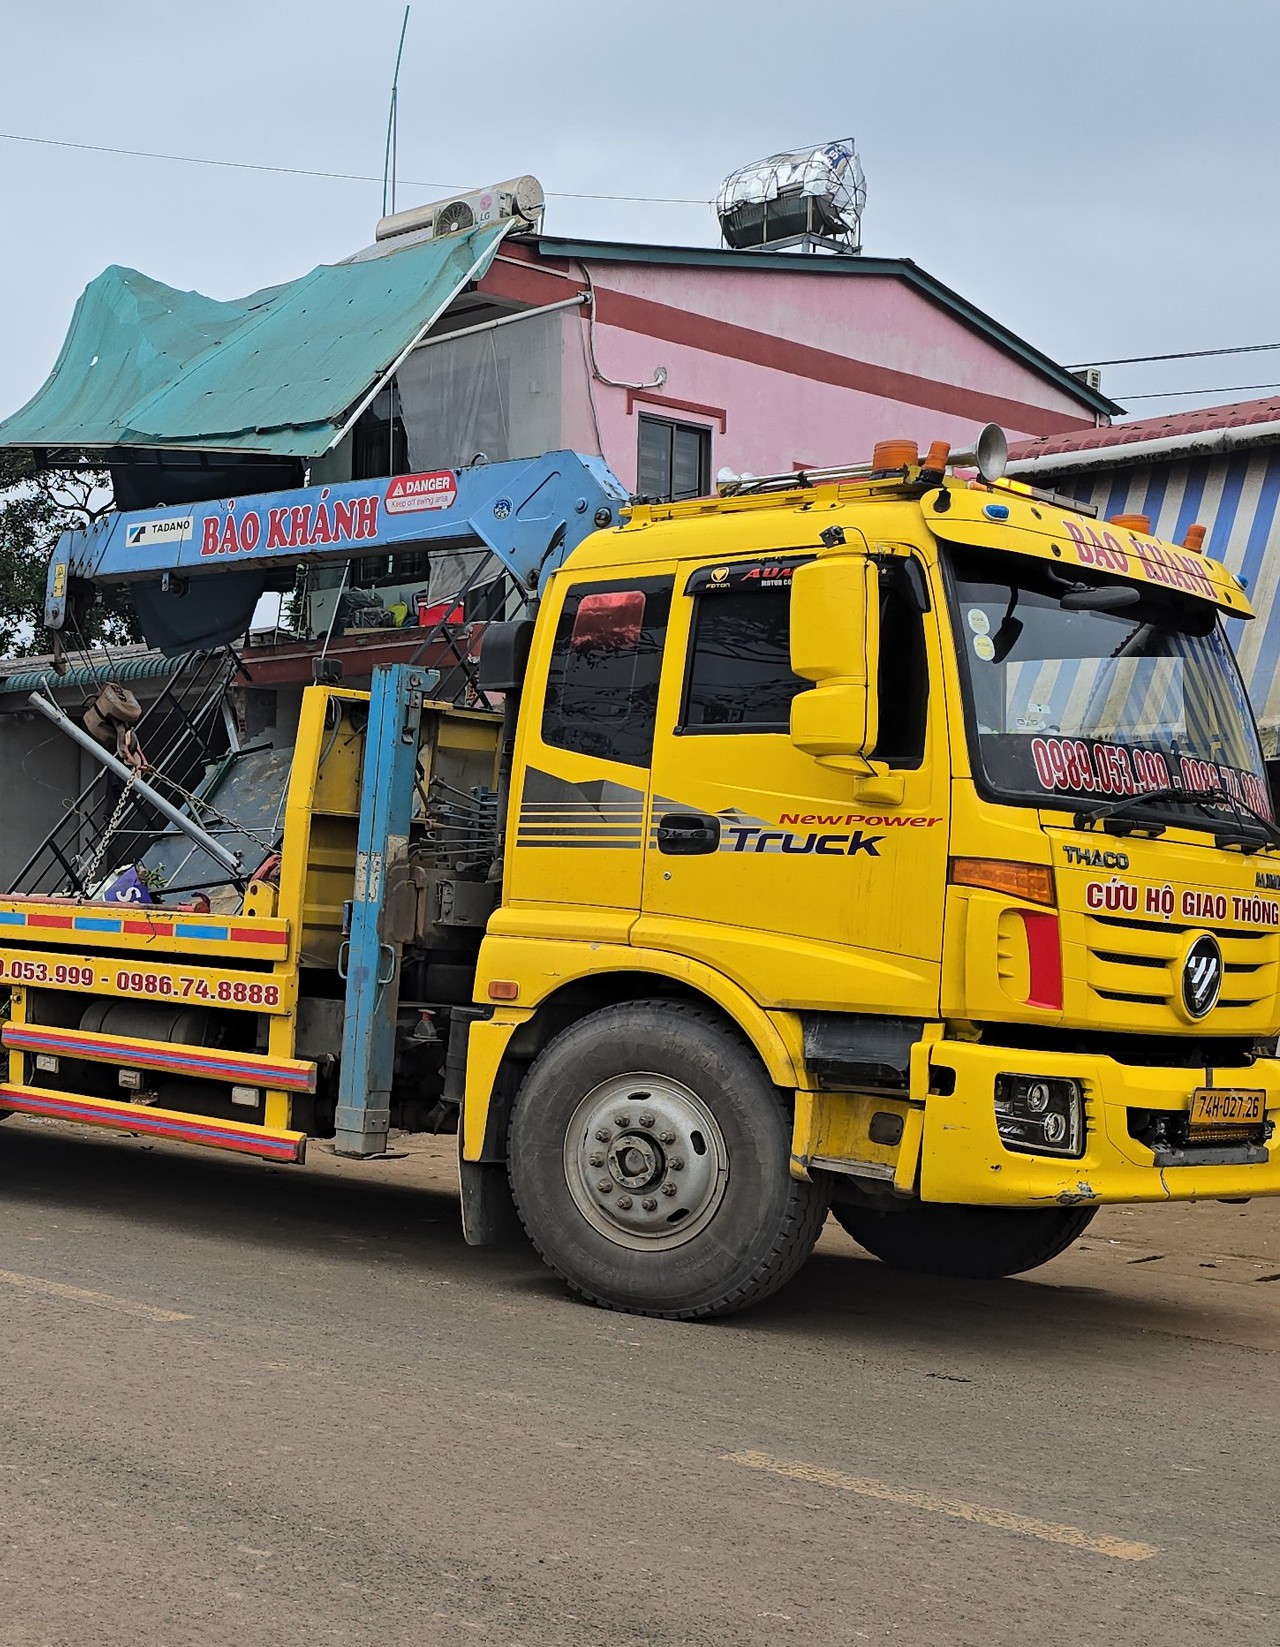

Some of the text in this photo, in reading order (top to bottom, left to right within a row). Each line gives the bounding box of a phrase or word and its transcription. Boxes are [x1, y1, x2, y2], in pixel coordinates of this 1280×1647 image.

[480, 212, 490, 221] LG
[406, 477, 451, 494] DANGER
[152, 520, 190, 534] TADANO
[201, 488, 380, 556] BẢO KHÁNH
[1031, 737, 1171, 796] 0989.053.999
[728, 827, 887, 857] Truck
[1063, 846, 1129, 870] THACO
[1086, 877, 1279, 926] CỨU HỘ GIAO THÔNG
[116, 970, 280, 1006] 0986.74.8888
[1198, 1095, 1259, 1118] 74H-027.26
